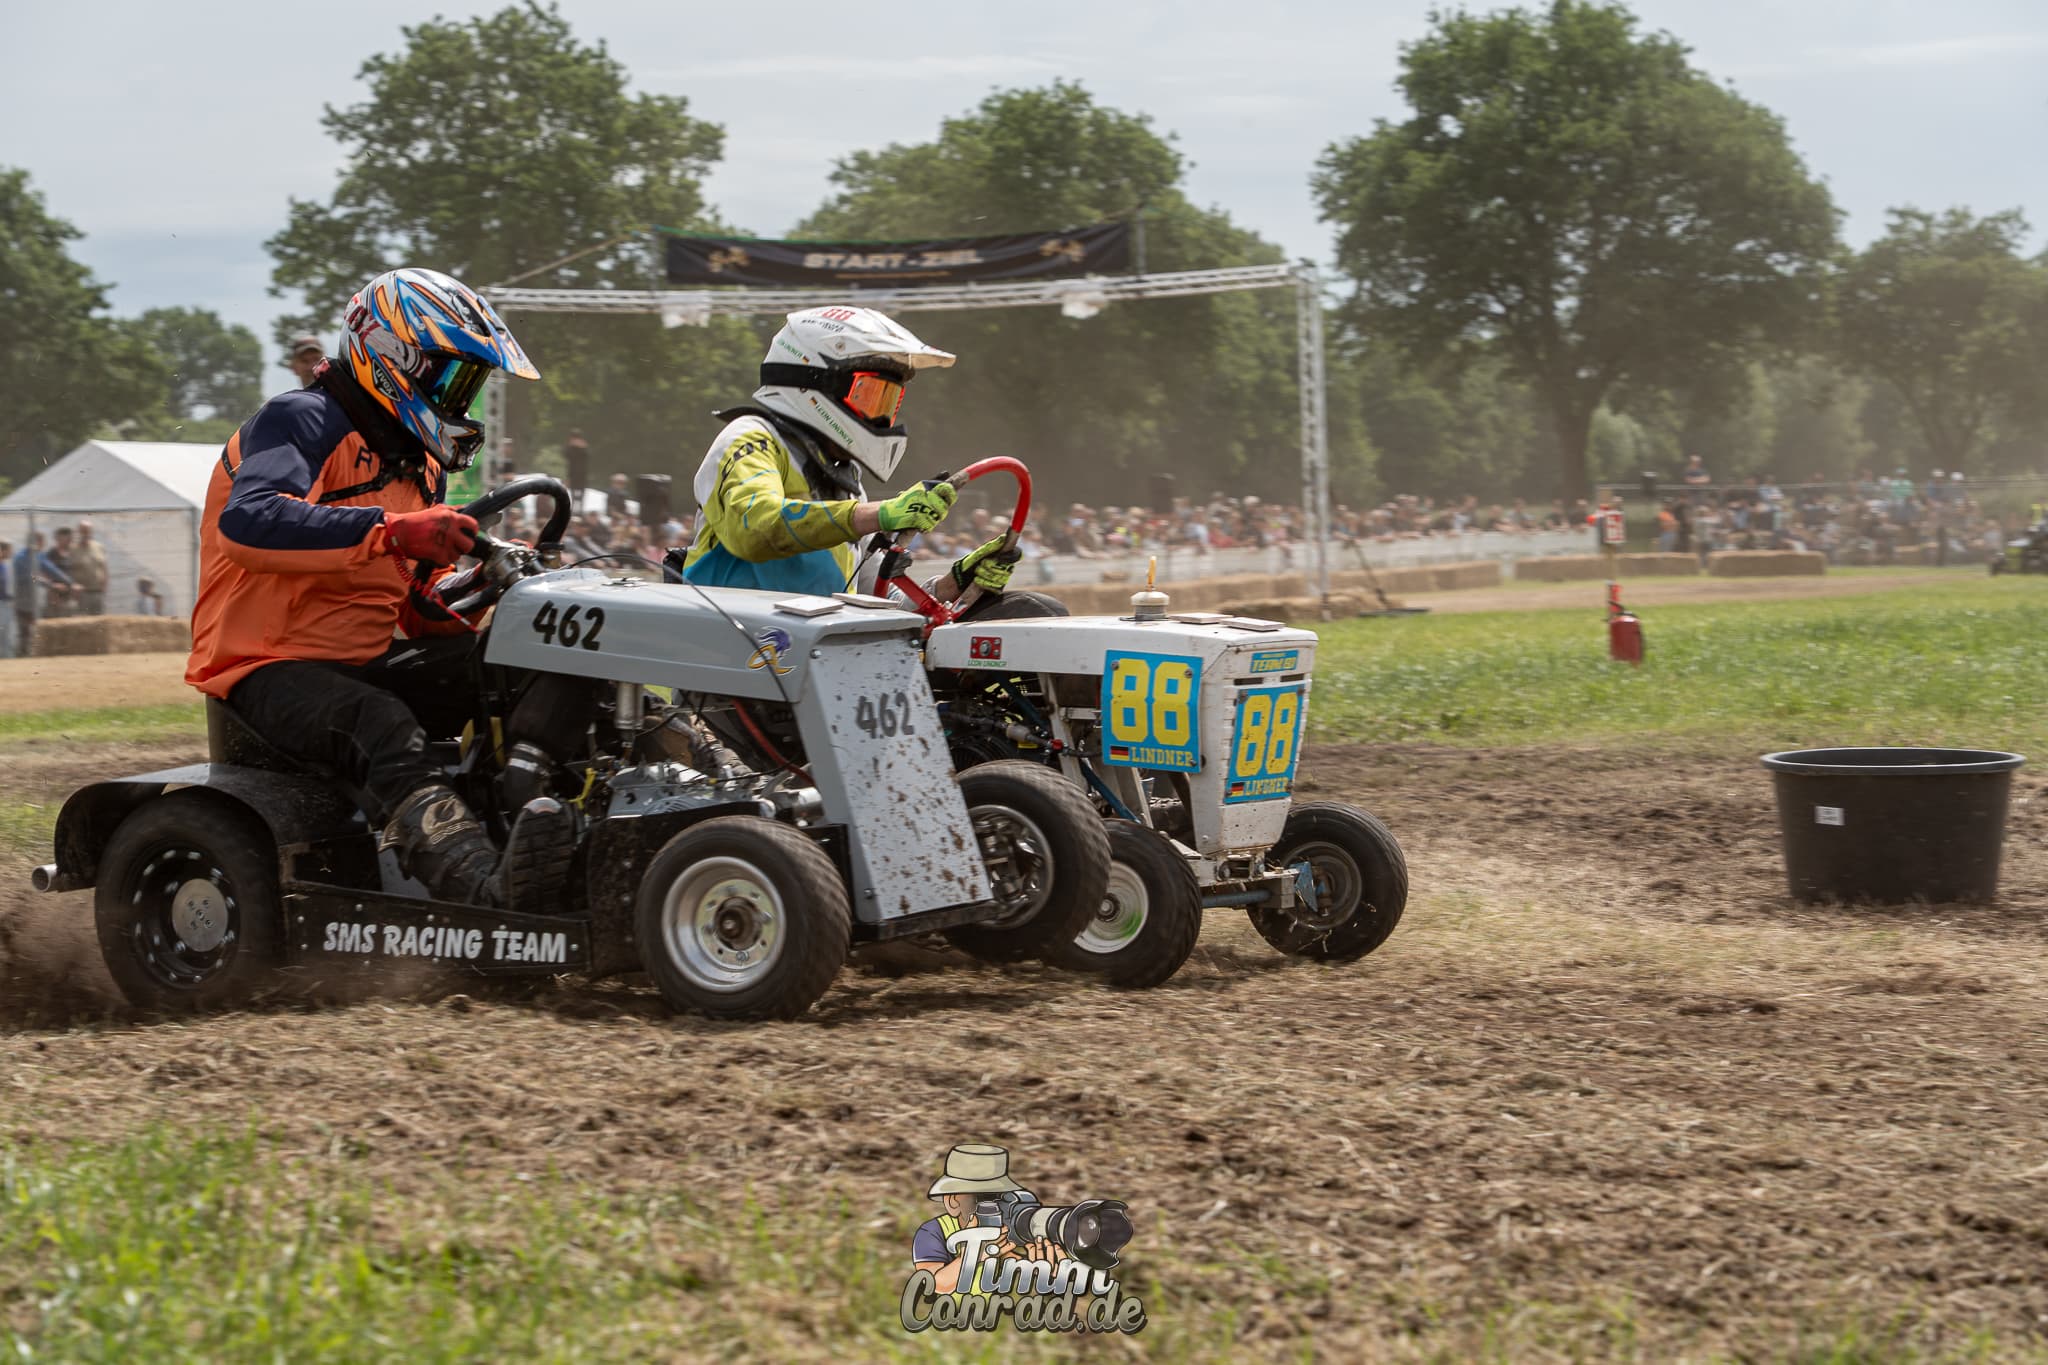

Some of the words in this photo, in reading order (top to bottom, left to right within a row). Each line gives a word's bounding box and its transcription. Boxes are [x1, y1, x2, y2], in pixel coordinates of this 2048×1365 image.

[533, 600, 605, 651] 462
[856, 692, 914, 739] 462
[1110, 658, 1192, 746] 88
[1131, 746, 1194, 767] LINDNER
[1236, 692, 1298, 777] 88
[324, 922, 376, 953] SMS
[383, 925, 483, 959] RACING
[492, 930, 566, 963] TEAM
